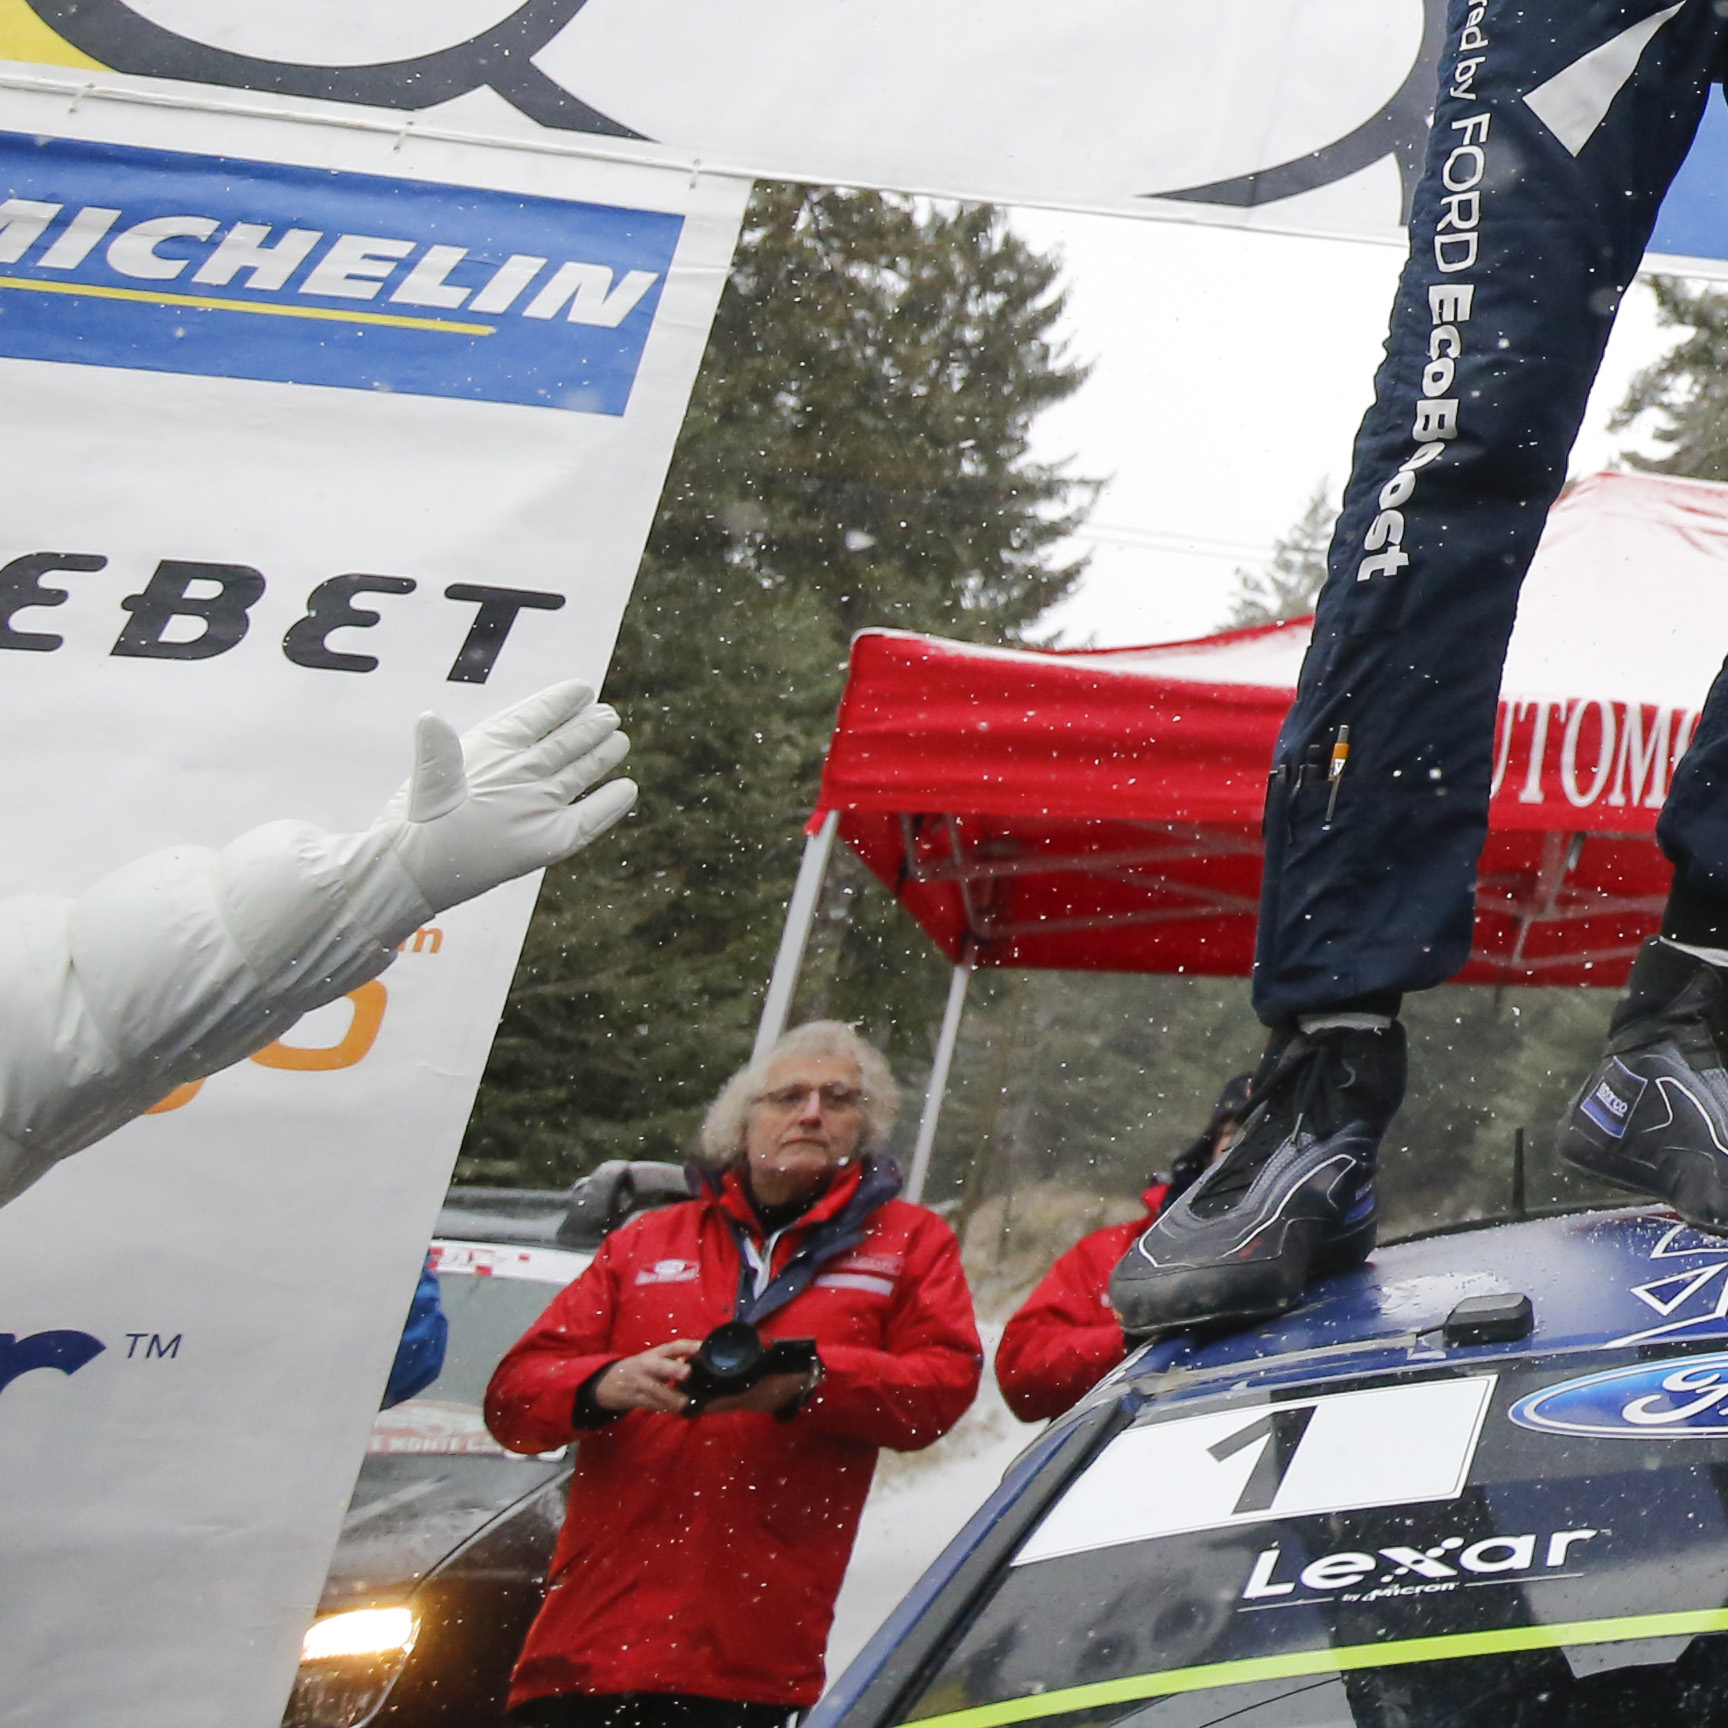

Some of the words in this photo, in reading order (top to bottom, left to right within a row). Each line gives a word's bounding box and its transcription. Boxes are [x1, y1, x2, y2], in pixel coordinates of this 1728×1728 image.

[1450, 56, 1486, 100] by
[1434, 112, 1491, 272] FORD
[1357, 284, 1476, 582] EcoBoost
[1206, 1404, 1318, 1515] 1
[1241, 1527, 1598, 1600] Lexar
[1342, 1593, 1361, 1603] by
[1362, 1581, 1459, 1603] Micron
